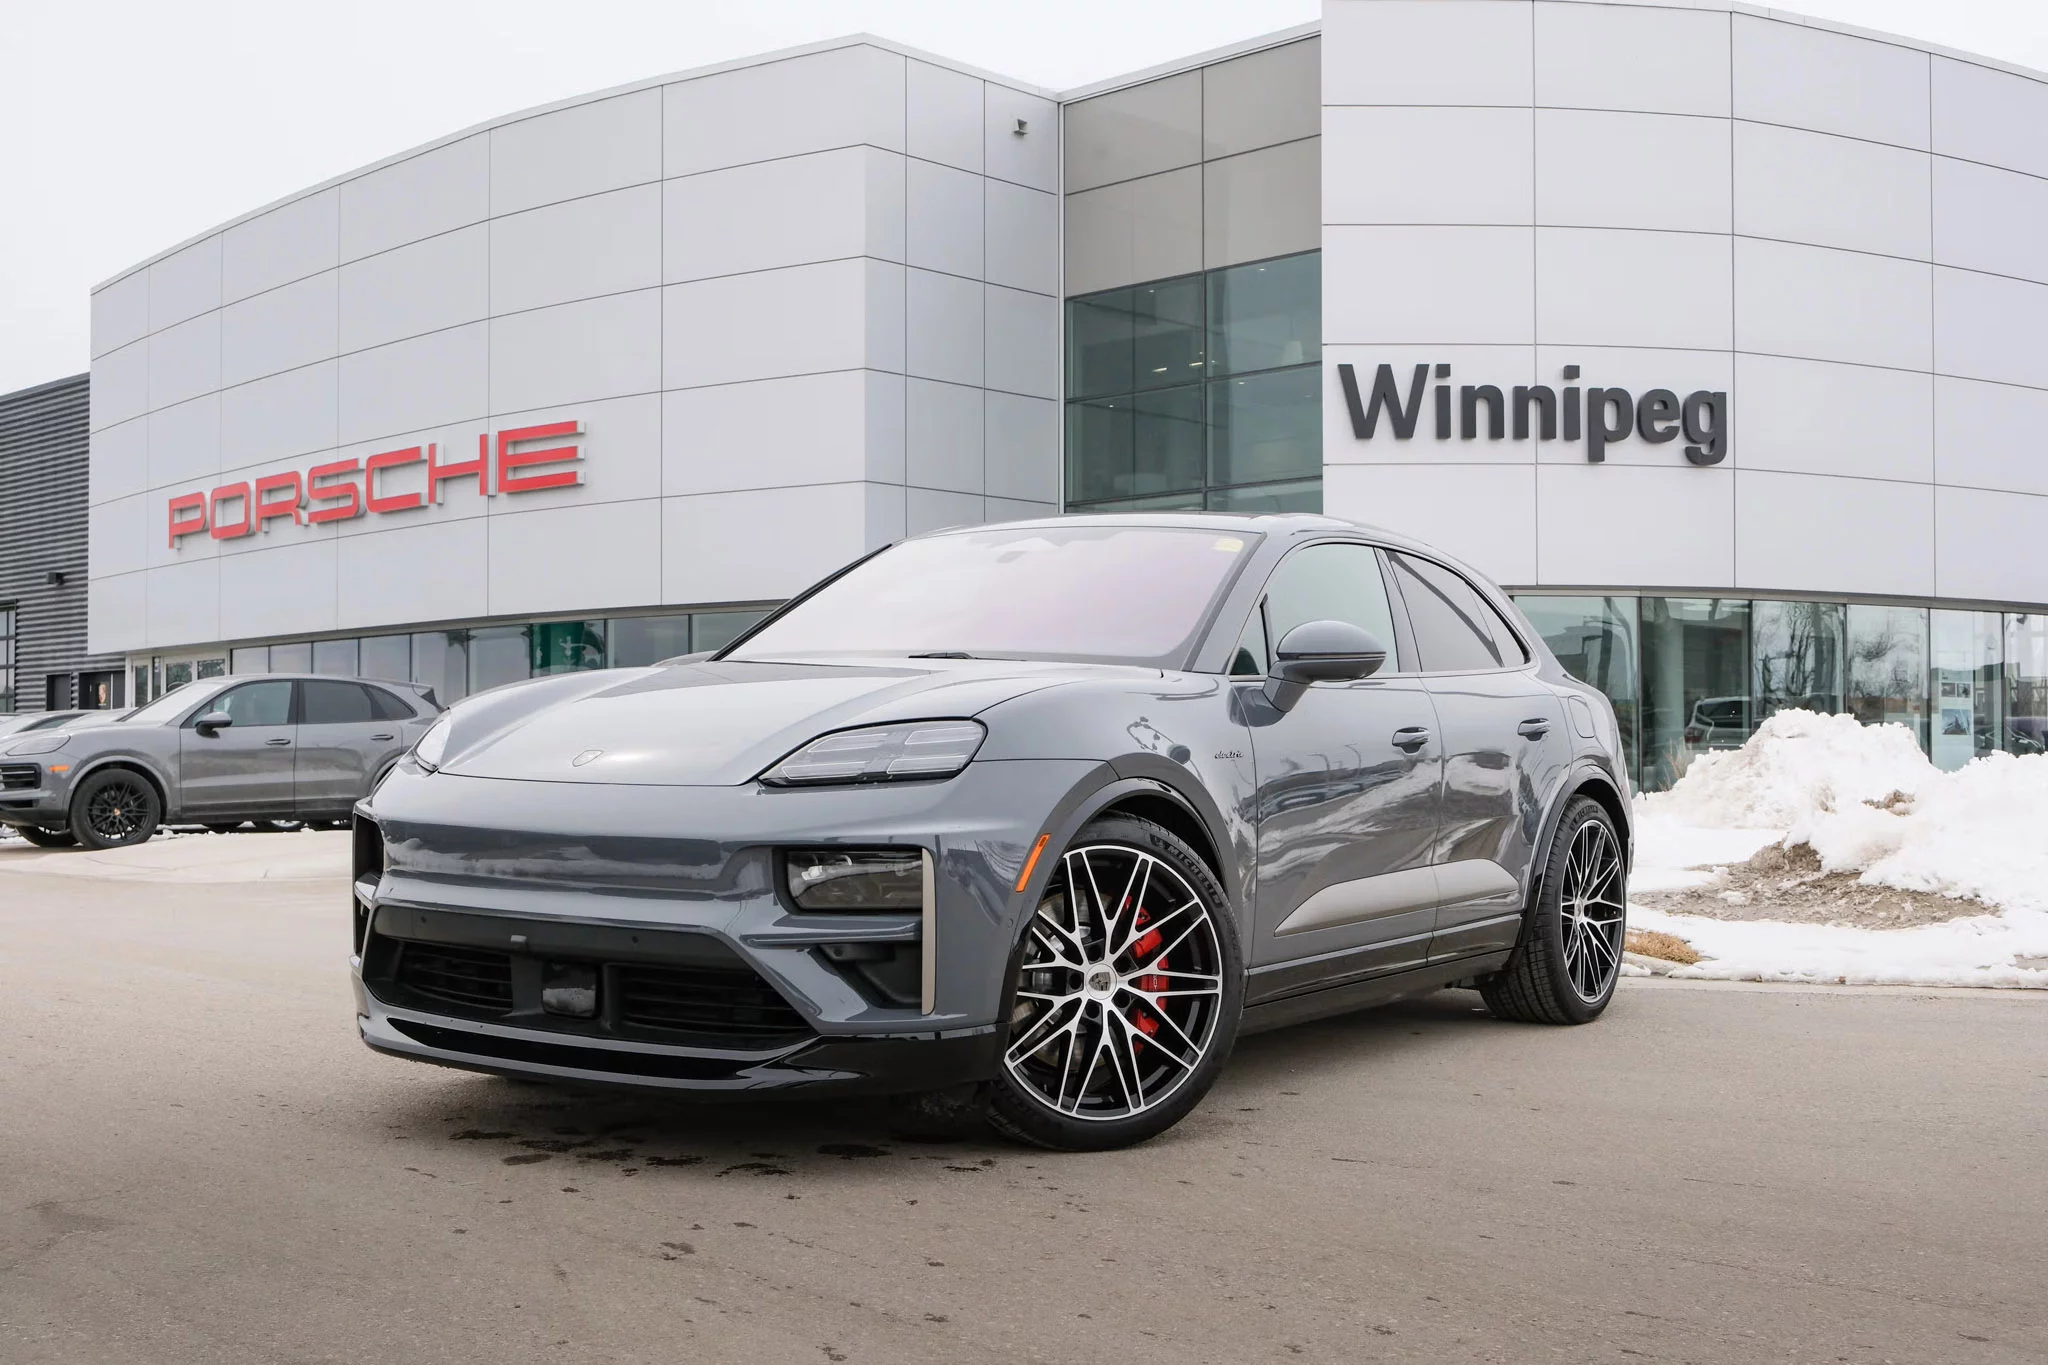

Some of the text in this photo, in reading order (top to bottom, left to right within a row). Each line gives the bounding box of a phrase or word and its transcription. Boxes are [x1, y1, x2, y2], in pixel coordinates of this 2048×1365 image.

[1338, 363, 1728, 467] Winnipeg
[168, 420, 585, 550] PORSCHE
[1167, 845, 1224, 906] MICHELIN
